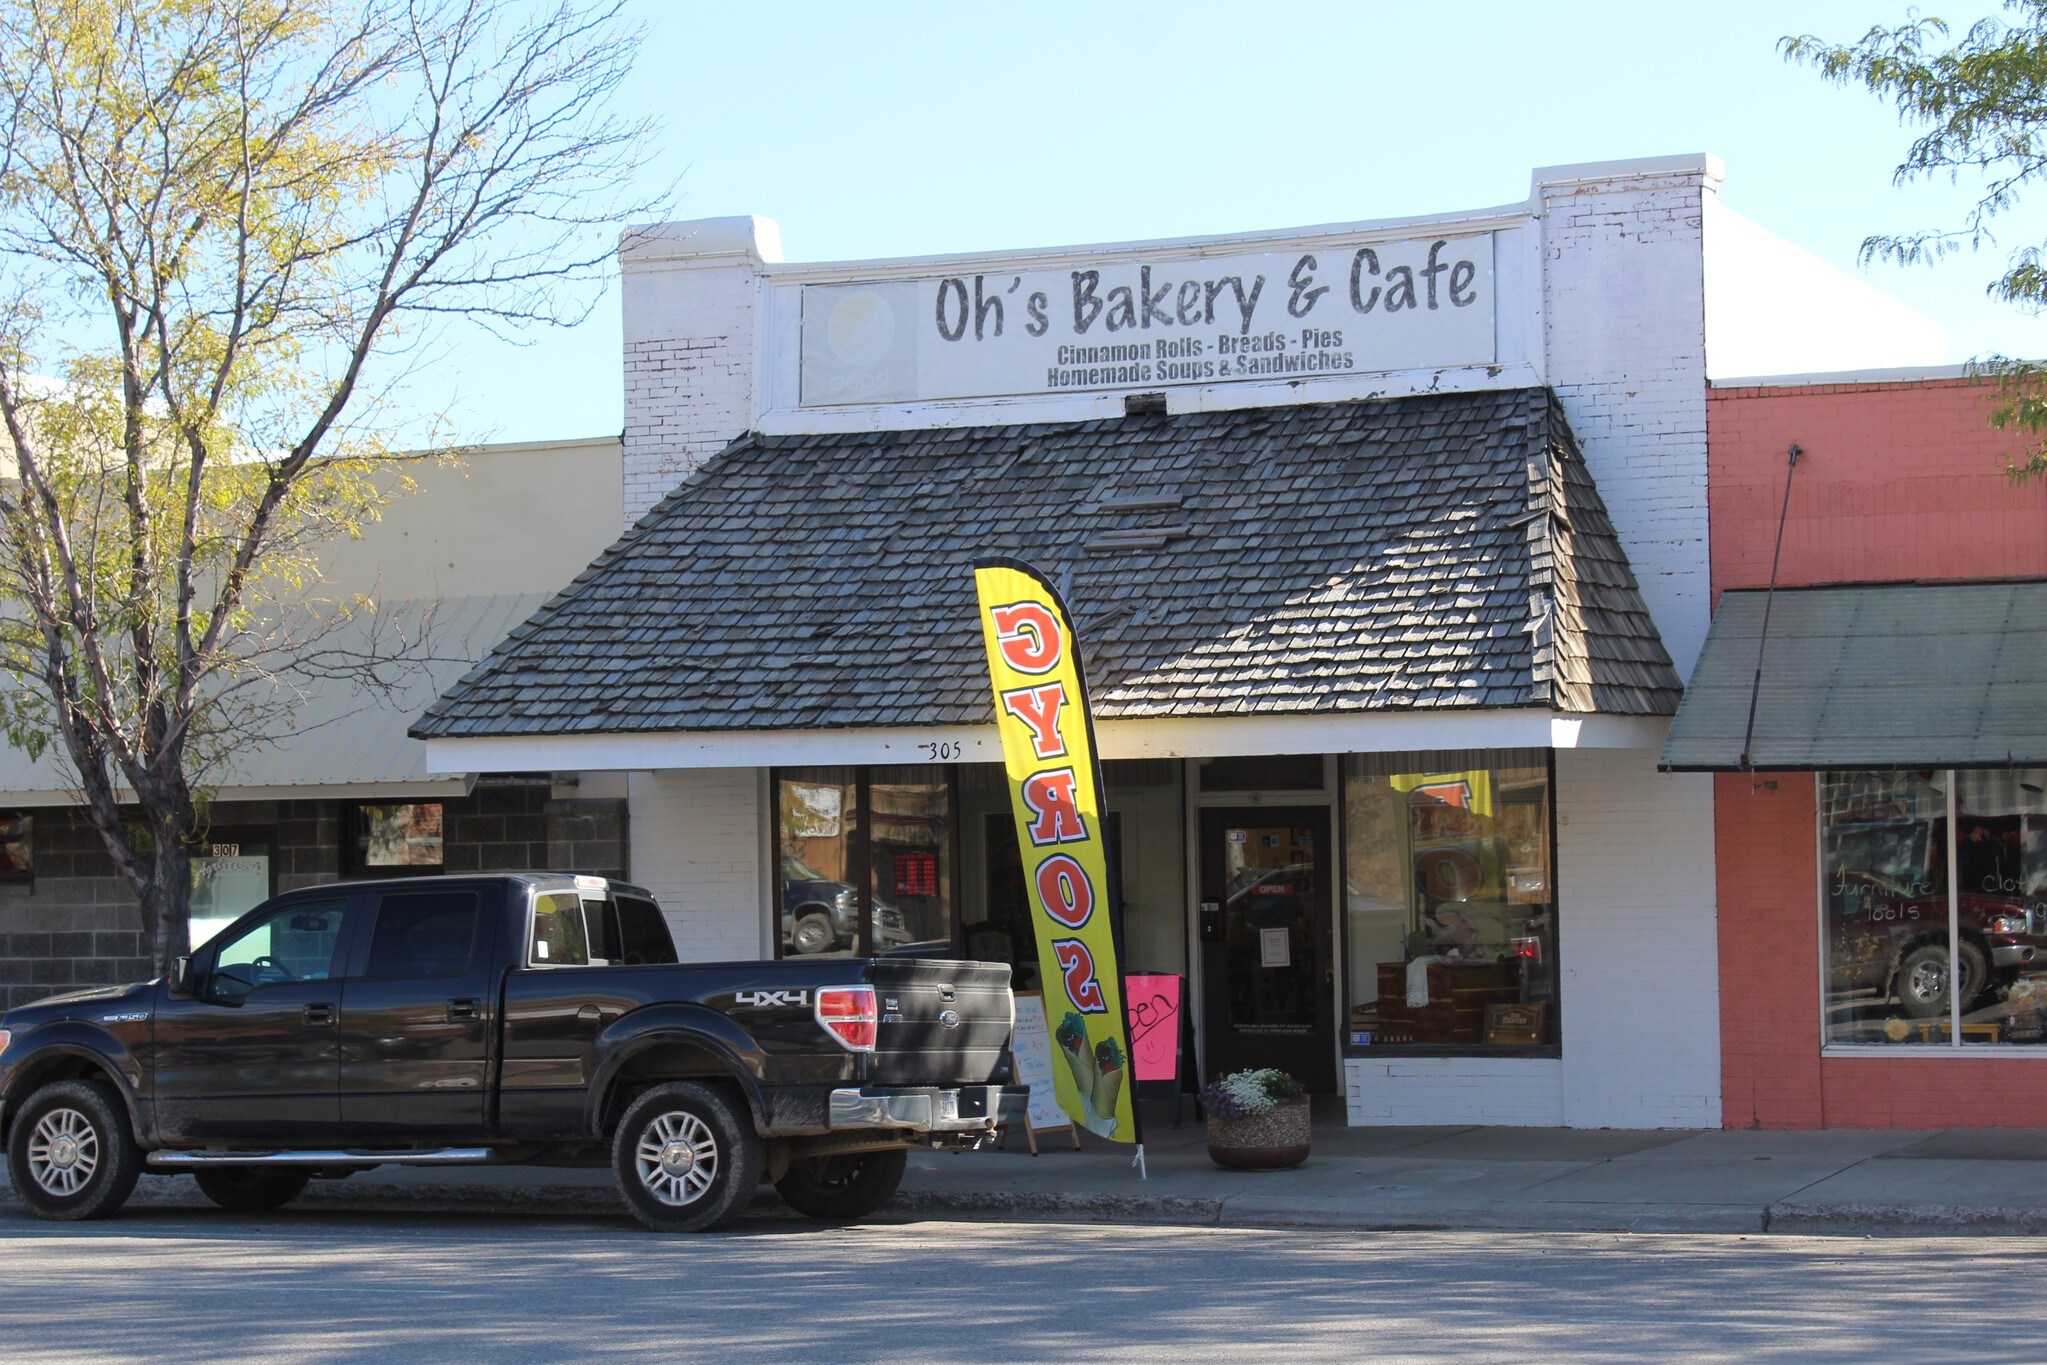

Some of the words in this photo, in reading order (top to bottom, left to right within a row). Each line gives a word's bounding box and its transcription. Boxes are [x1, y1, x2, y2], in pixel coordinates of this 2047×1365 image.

[935, 275, 1049, 342] Oh's
[1071, 265, 1266, 335] Bakery
[1287, 254, 1330, 318] &
[1350, 240, 1477, 315] Cafe
[1057, 344, 1151, 366] Cinnamon
[1156, 337, 1203, 360] Rolls
[1218, 331, 1286, 355] Breads
[1302, 328, 1343, 349] Pies
[1047, 362, 1151, 387] Homemade
[1156, 360, 1214, 380] Soups
[1218, 360, 1234, 376] &
[1236, 350, 1354, 375] Sandwiches
[929, 741, 961, 760] 305
[213, 845, 238, 856] 307
[1259, 885, 1285, 893] OPEN
[1867, 903, 1921, 921] Tools
[1128, 994, 1176, 1042] pen
